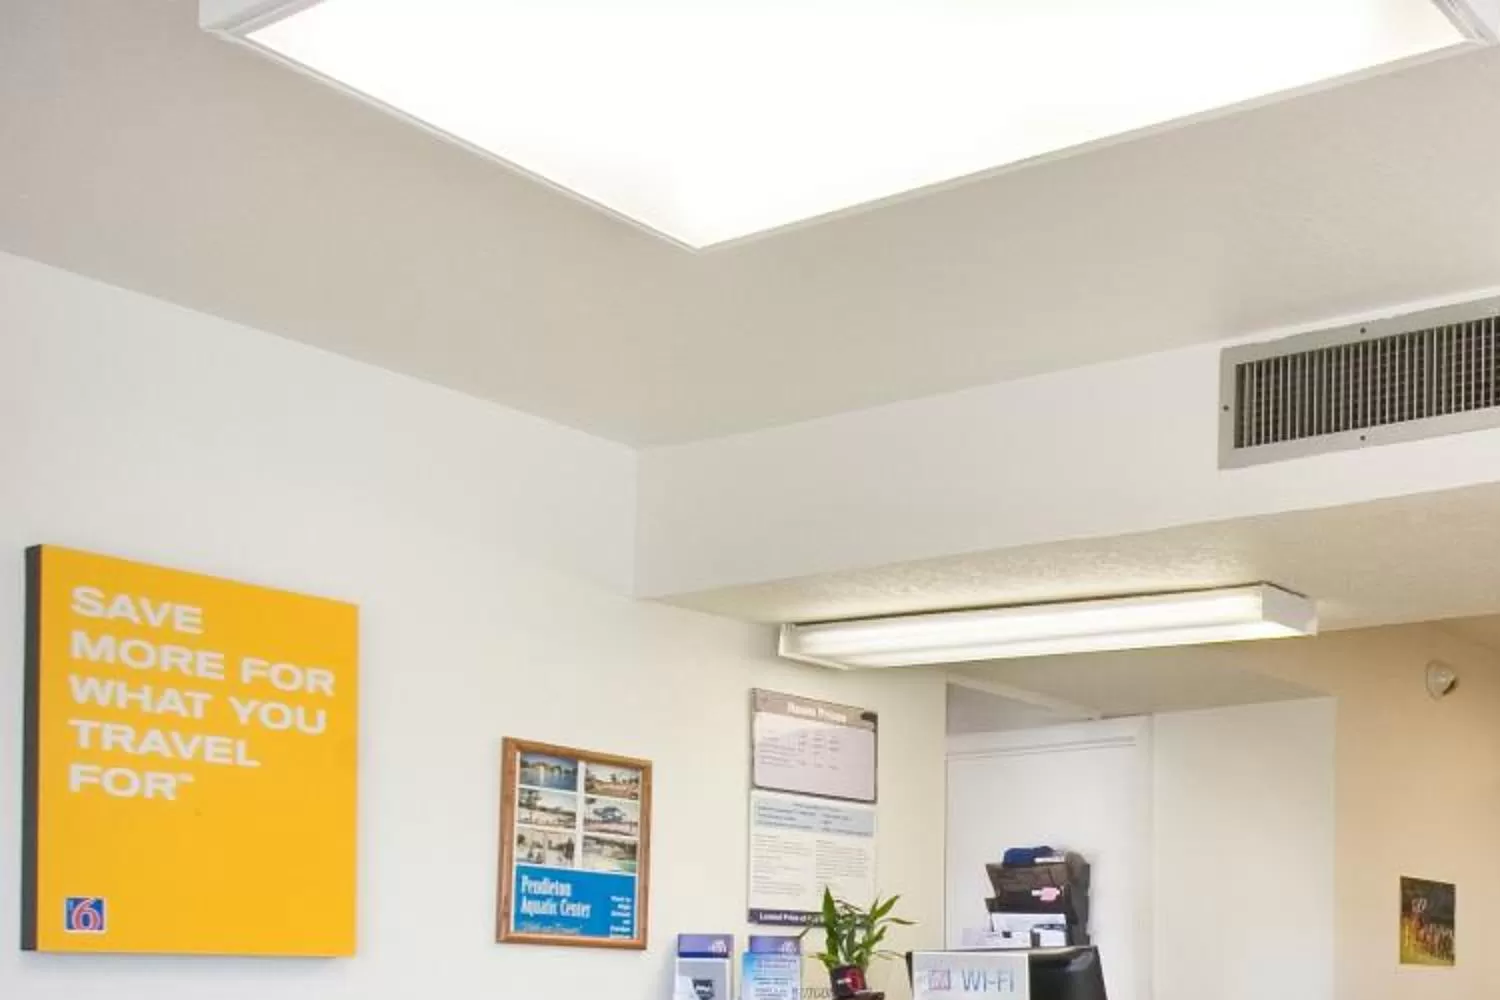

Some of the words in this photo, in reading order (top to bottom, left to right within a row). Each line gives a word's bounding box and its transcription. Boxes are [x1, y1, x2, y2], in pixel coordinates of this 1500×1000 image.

[72, 586, 202, 632] SAVE
[71, 631, 225, 680] MORE
[241, 657, 335, 696] FOR
[68, 674, 211, 719] WHAT
[229, 696, 326, 735] YOU
[68, 719, 260, 767] TRAVEL
[521, 874, 572, 897] Pendleton
[72, 899, 102, 930] 6
[520, 895, 557, 917] Aquatic
[559, 898, 592, 919] Center
[961, 968, 1015, 993] WI-FI
